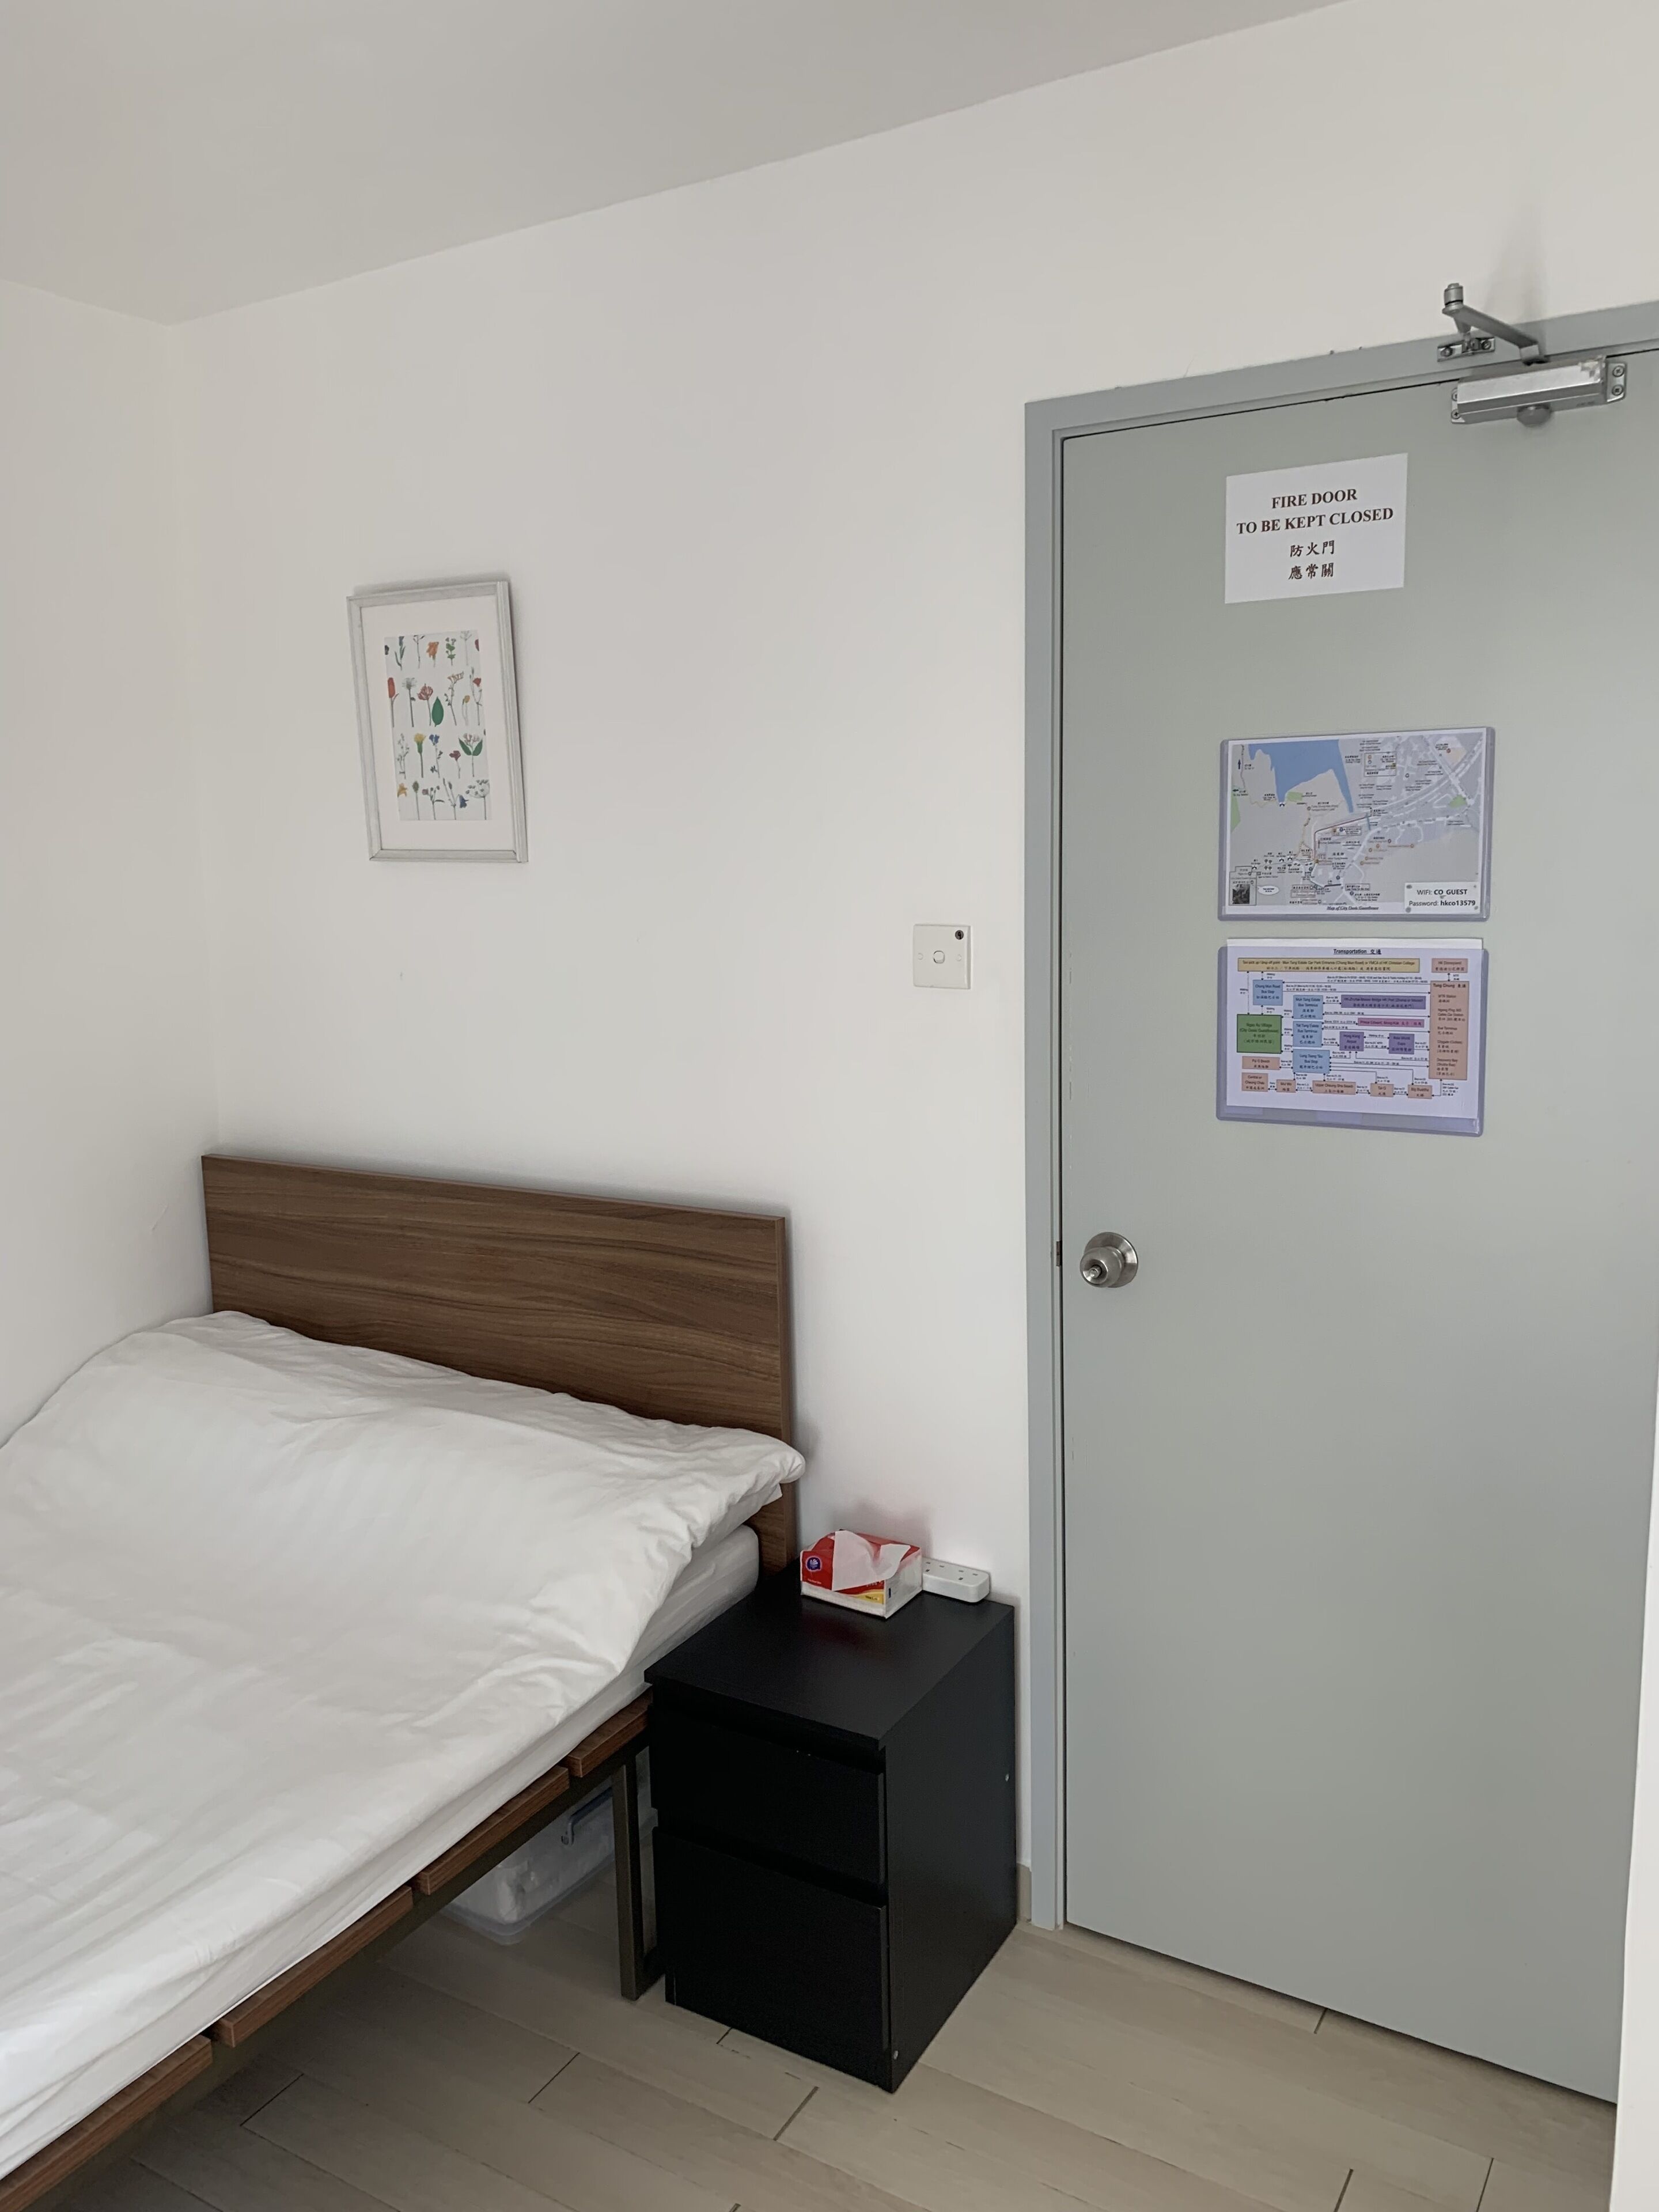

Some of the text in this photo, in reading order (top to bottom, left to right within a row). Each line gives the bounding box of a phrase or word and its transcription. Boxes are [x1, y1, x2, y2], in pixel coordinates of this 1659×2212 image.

[1272, 488, 1357, 509] FIRE DOOR
[1237, 507, 1393, 534] TO BE KEPT CLOSED
[1290, 540, 1335, 557] 防火門
[1289, 563, 1334, 579] 應常關
